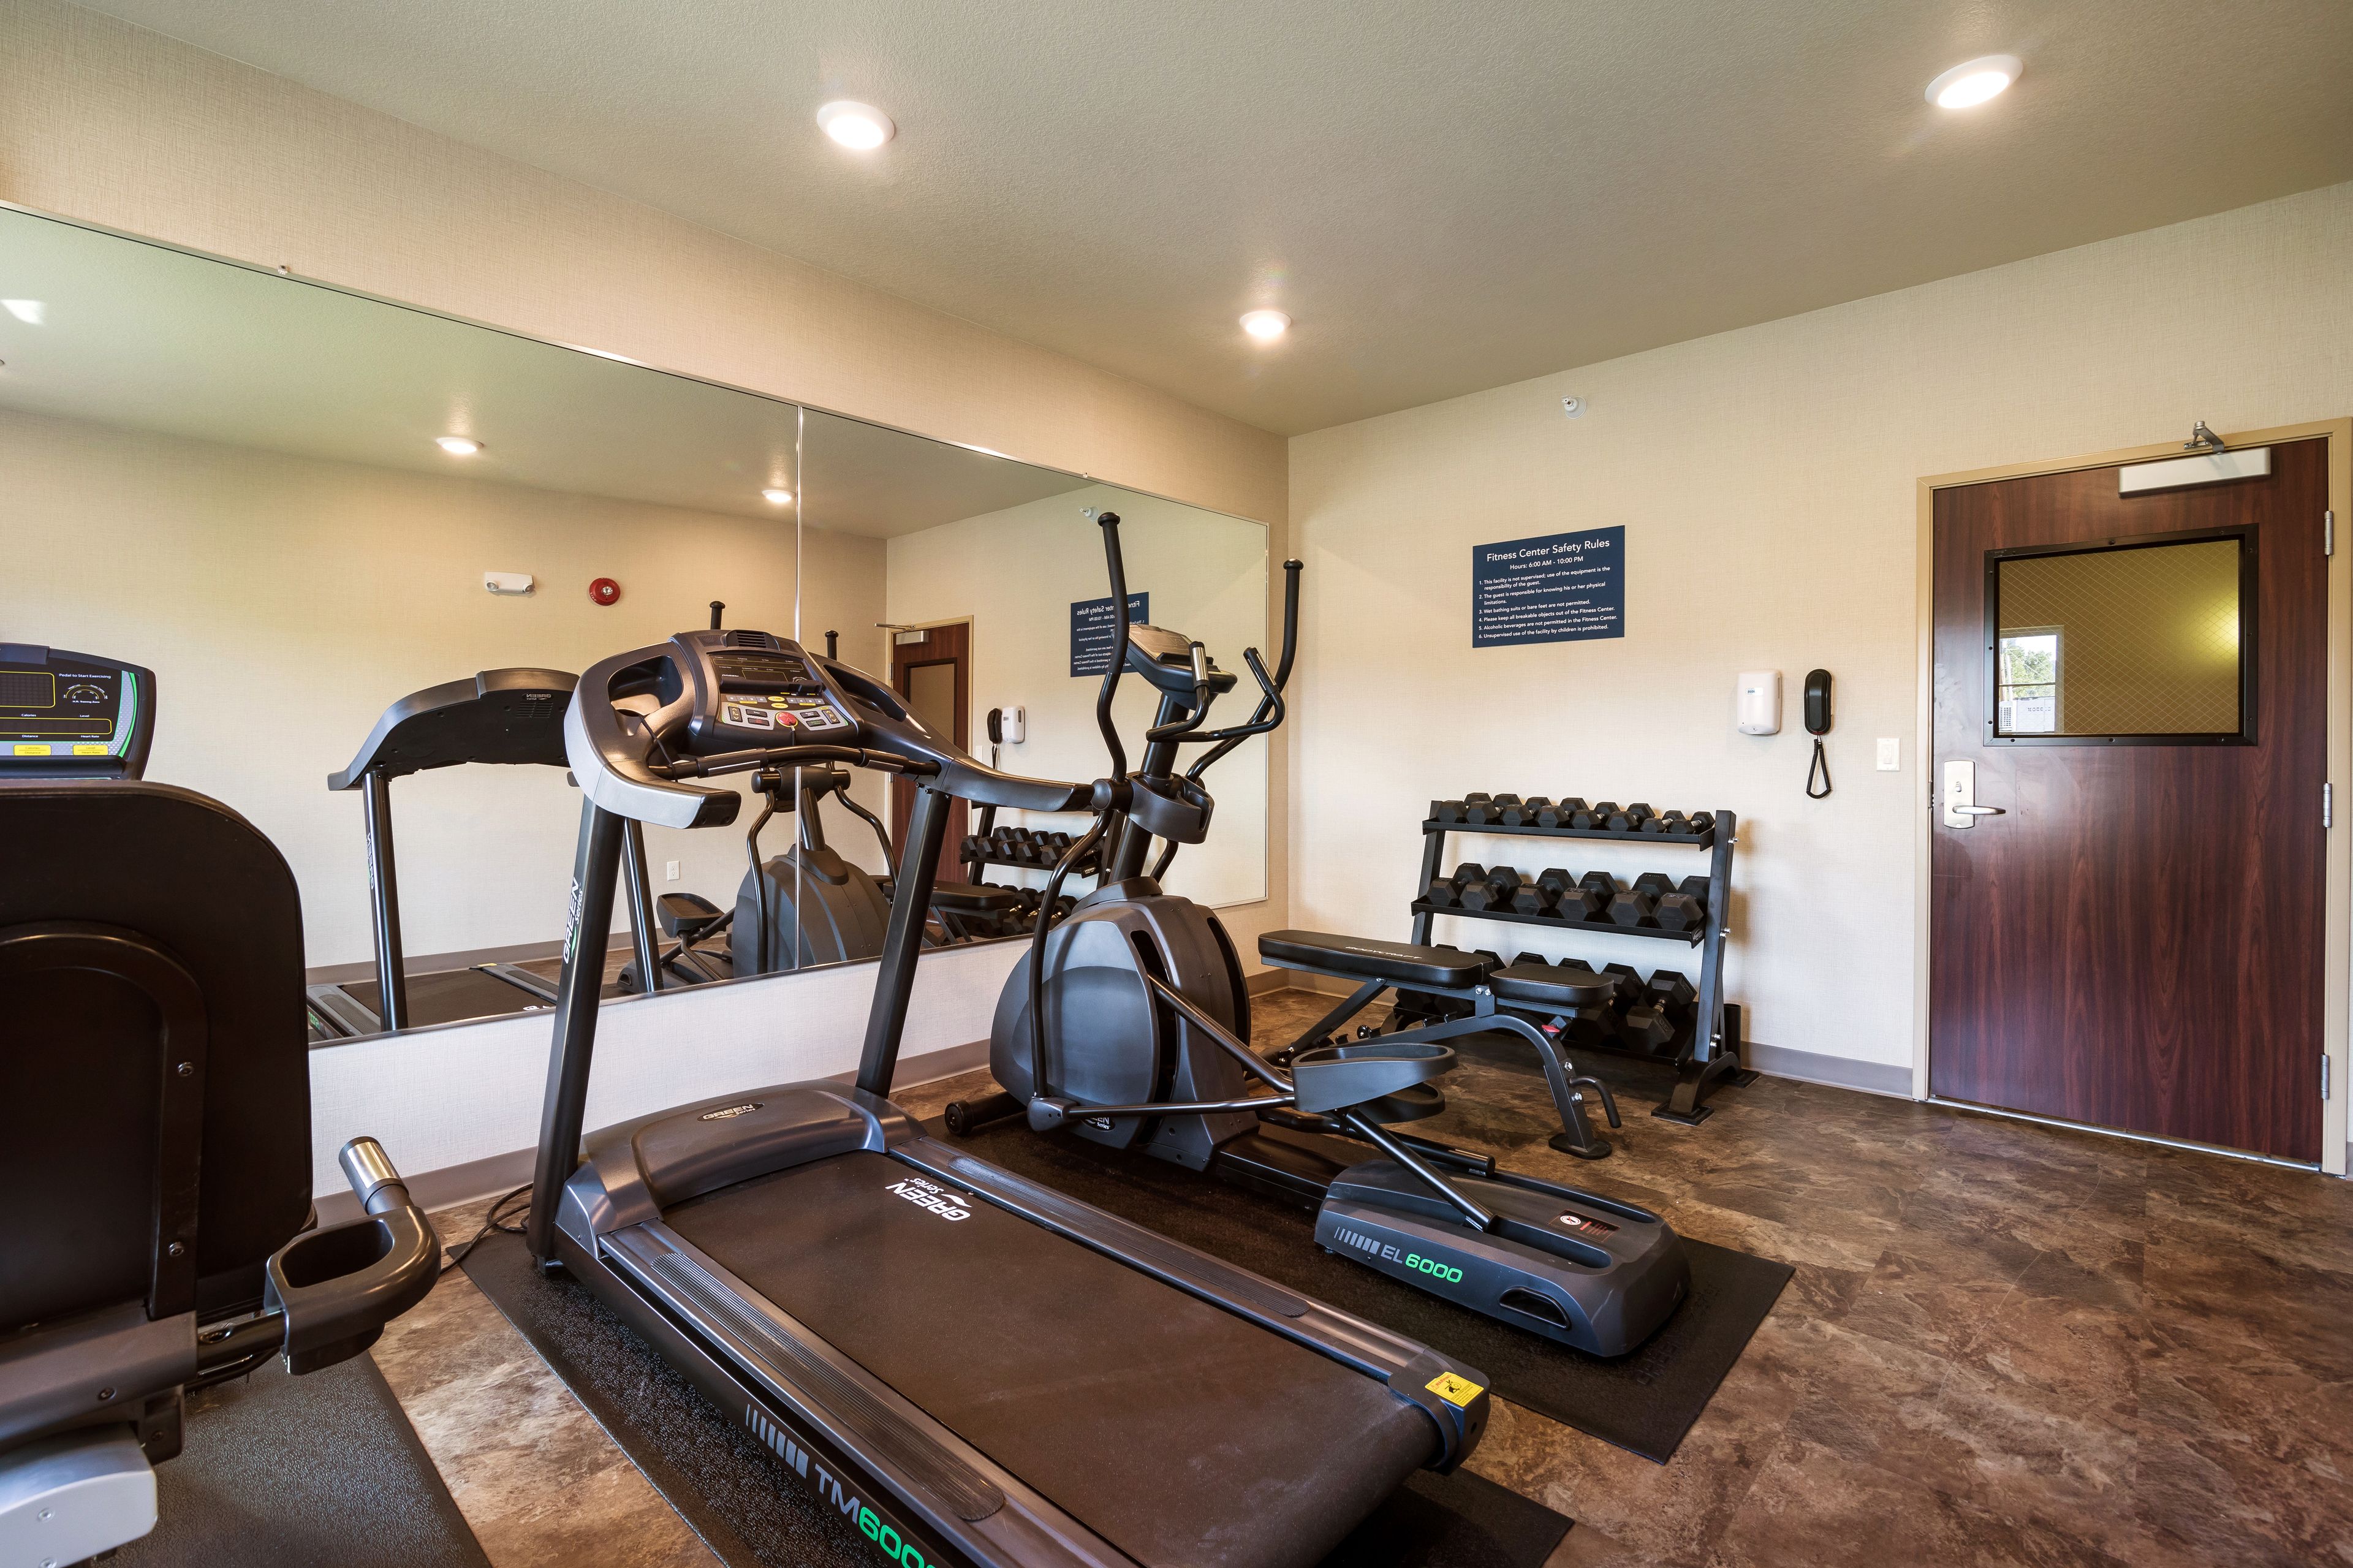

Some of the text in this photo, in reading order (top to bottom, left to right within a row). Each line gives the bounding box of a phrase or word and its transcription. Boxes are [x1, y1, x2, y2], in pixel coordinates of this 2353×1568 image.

[1487, 539, 1610, 562] Fitness Center Safety Rules
[563, 876, 579, 964] GREEN
[703, 1104, 754, 1119] GREEN
[885, 1182, 971, 1221] GREEN
[910, 1178, 944, 1194] Series
[815, 1463, 938, 1568] TM600
